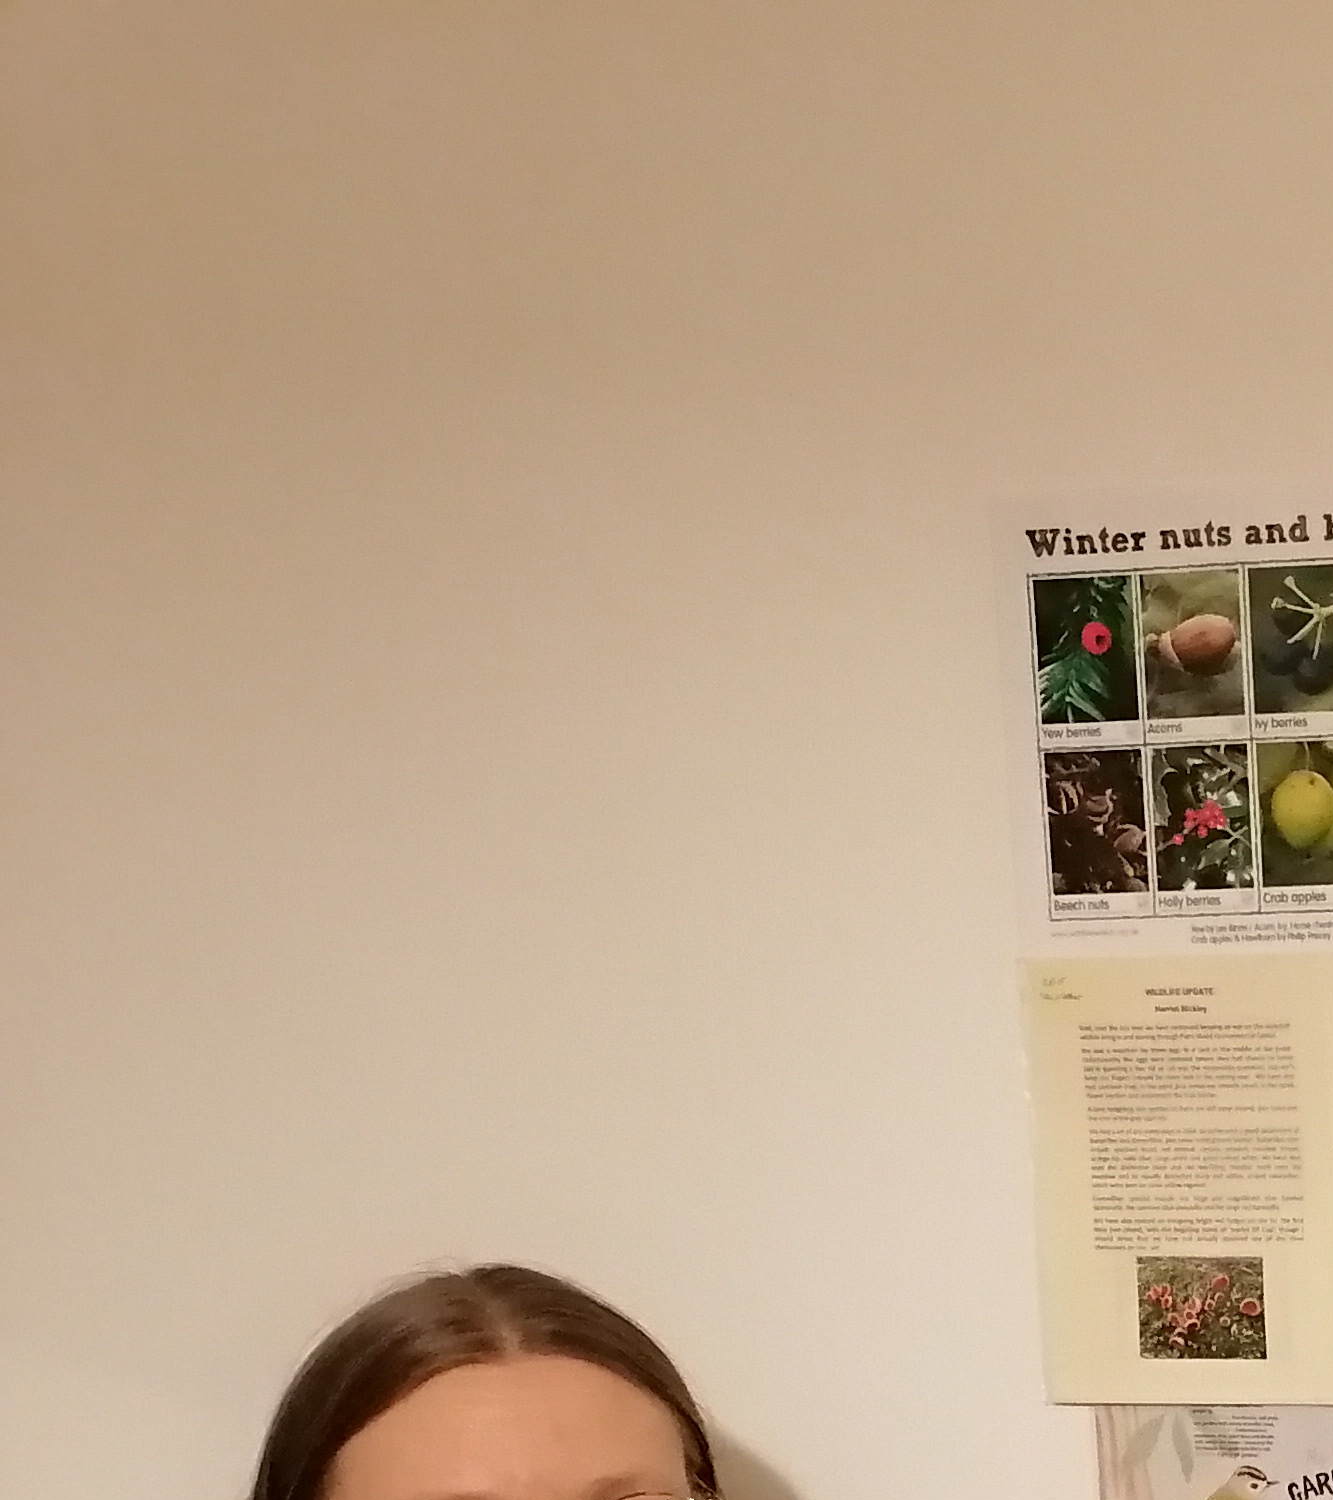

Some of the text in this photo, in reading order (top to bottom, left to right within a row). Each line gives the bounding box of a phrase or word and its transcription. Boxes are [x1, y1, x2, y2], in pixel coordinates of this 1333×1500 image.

[1024, 526, 1147, 559] Winter
[1159, 520, 1232, 551] nuts
[1244, 513, 1310, 547] and
